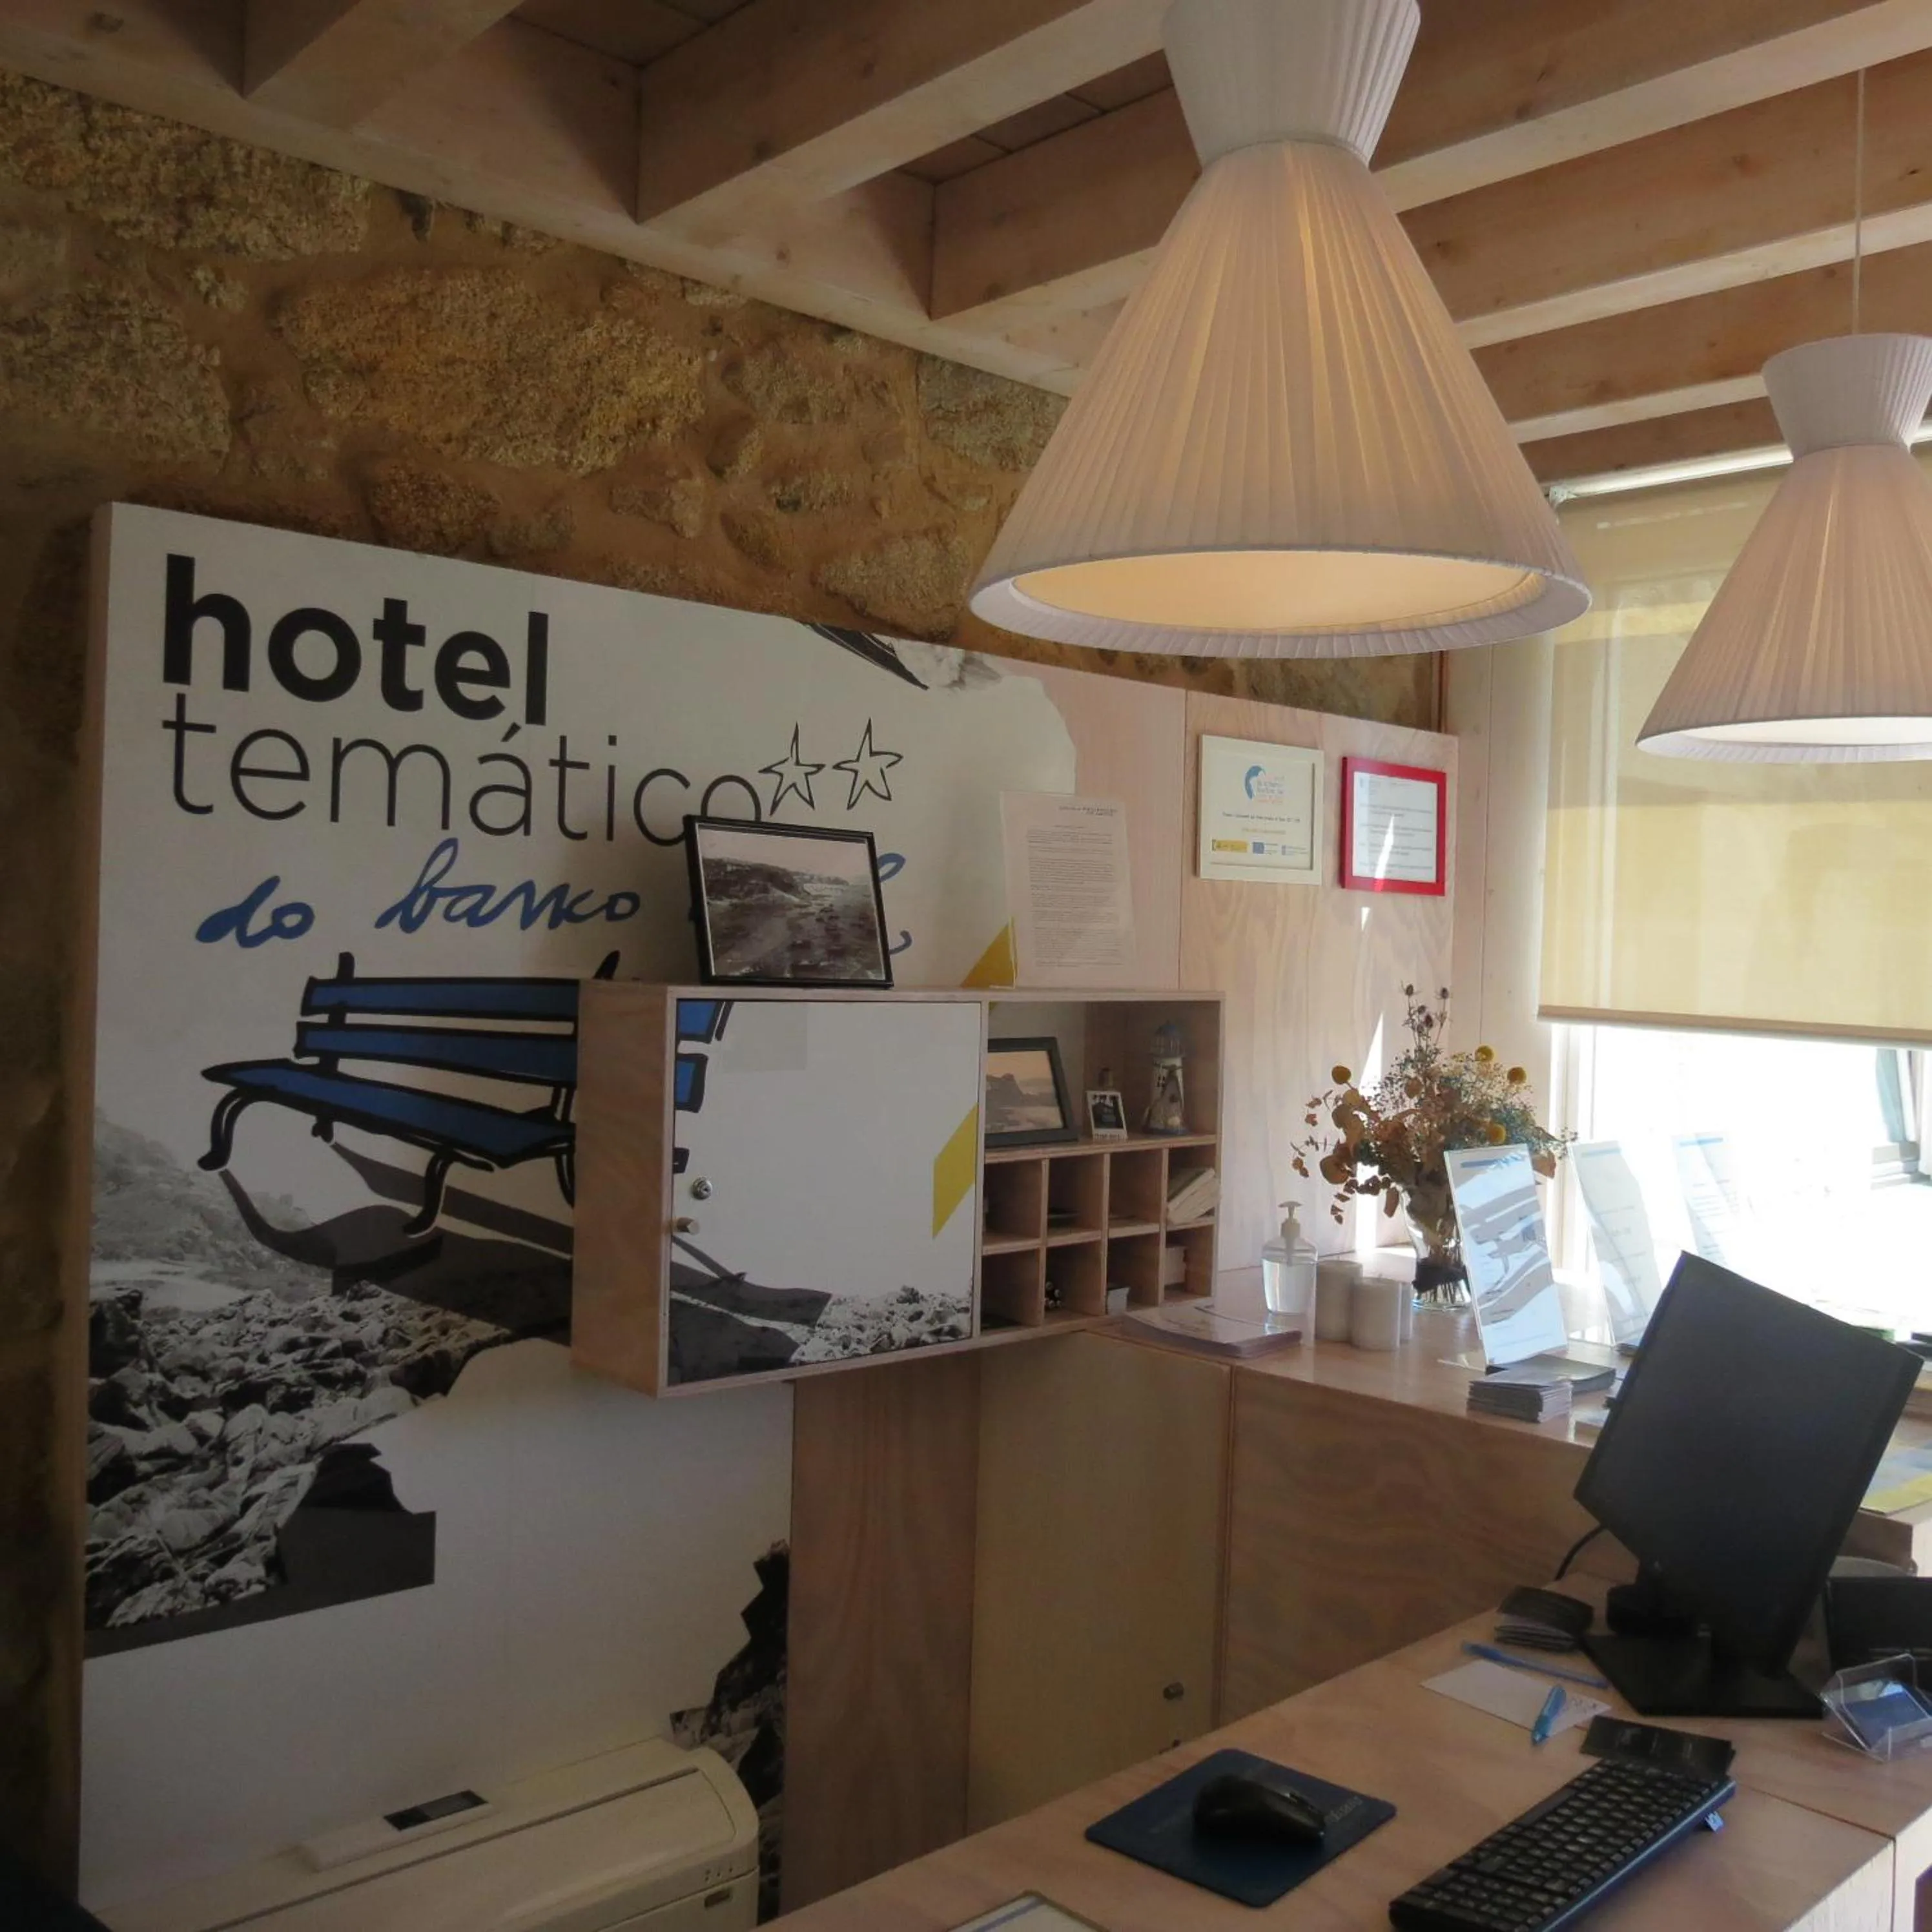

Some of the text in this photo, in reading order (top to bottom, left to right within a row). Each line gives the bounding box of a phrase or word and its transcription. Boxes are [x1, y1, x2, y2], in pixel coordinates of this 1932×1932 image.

[163, 553, 549, 726] hotel
[195, 876, 314, 949] do
[375, 838, 641, 934] banco
